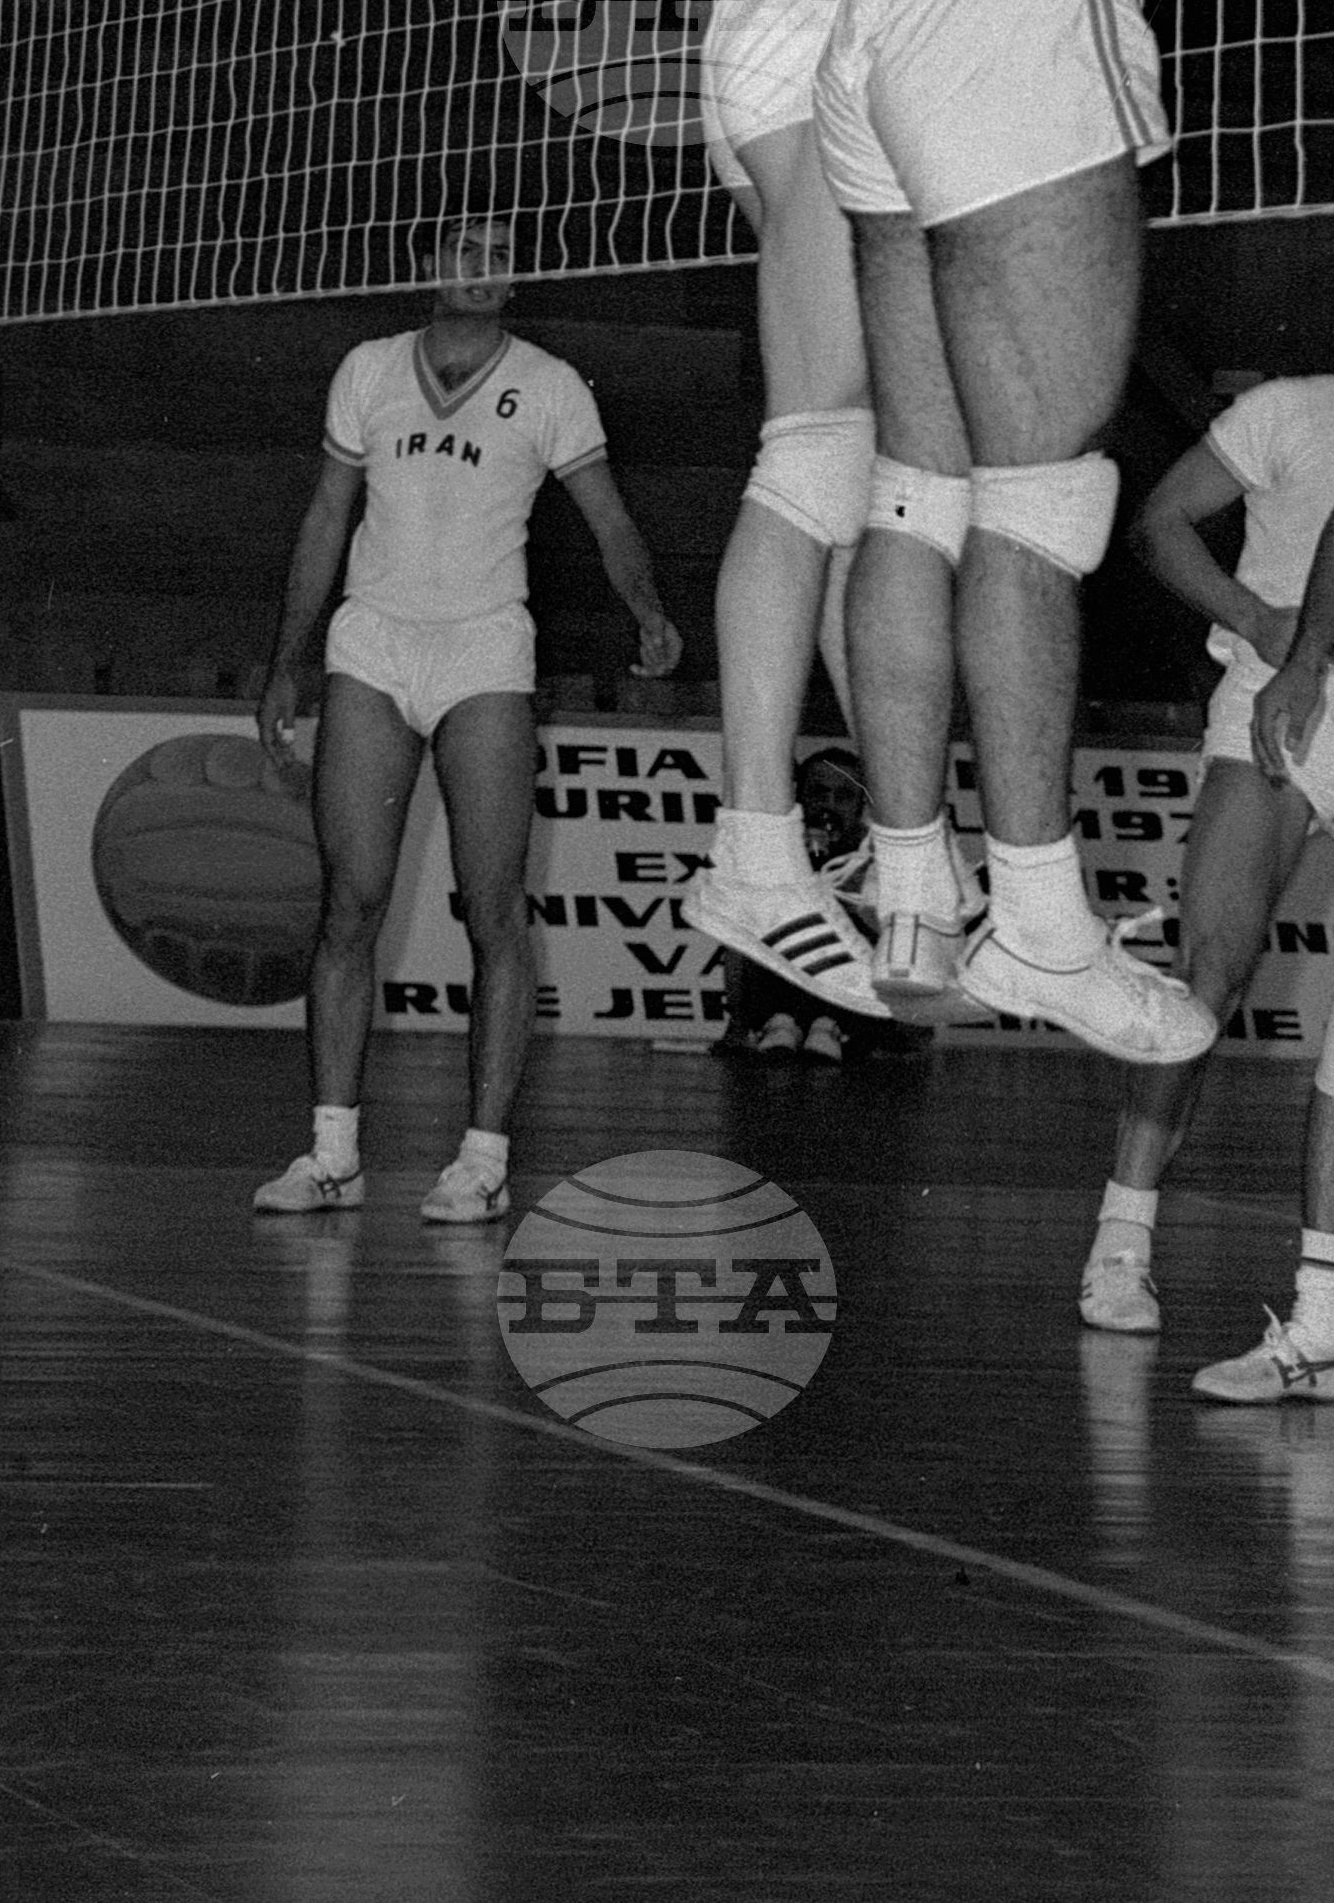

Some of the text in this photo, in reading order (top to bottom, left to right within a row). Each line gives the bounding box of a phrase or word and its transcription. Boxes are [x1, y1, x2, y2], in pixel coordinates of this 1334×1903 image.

[495, 388, 521, 419] 6
[396, 432, 481, 467] IRAN
[535, 744, 708, 780] FIA
